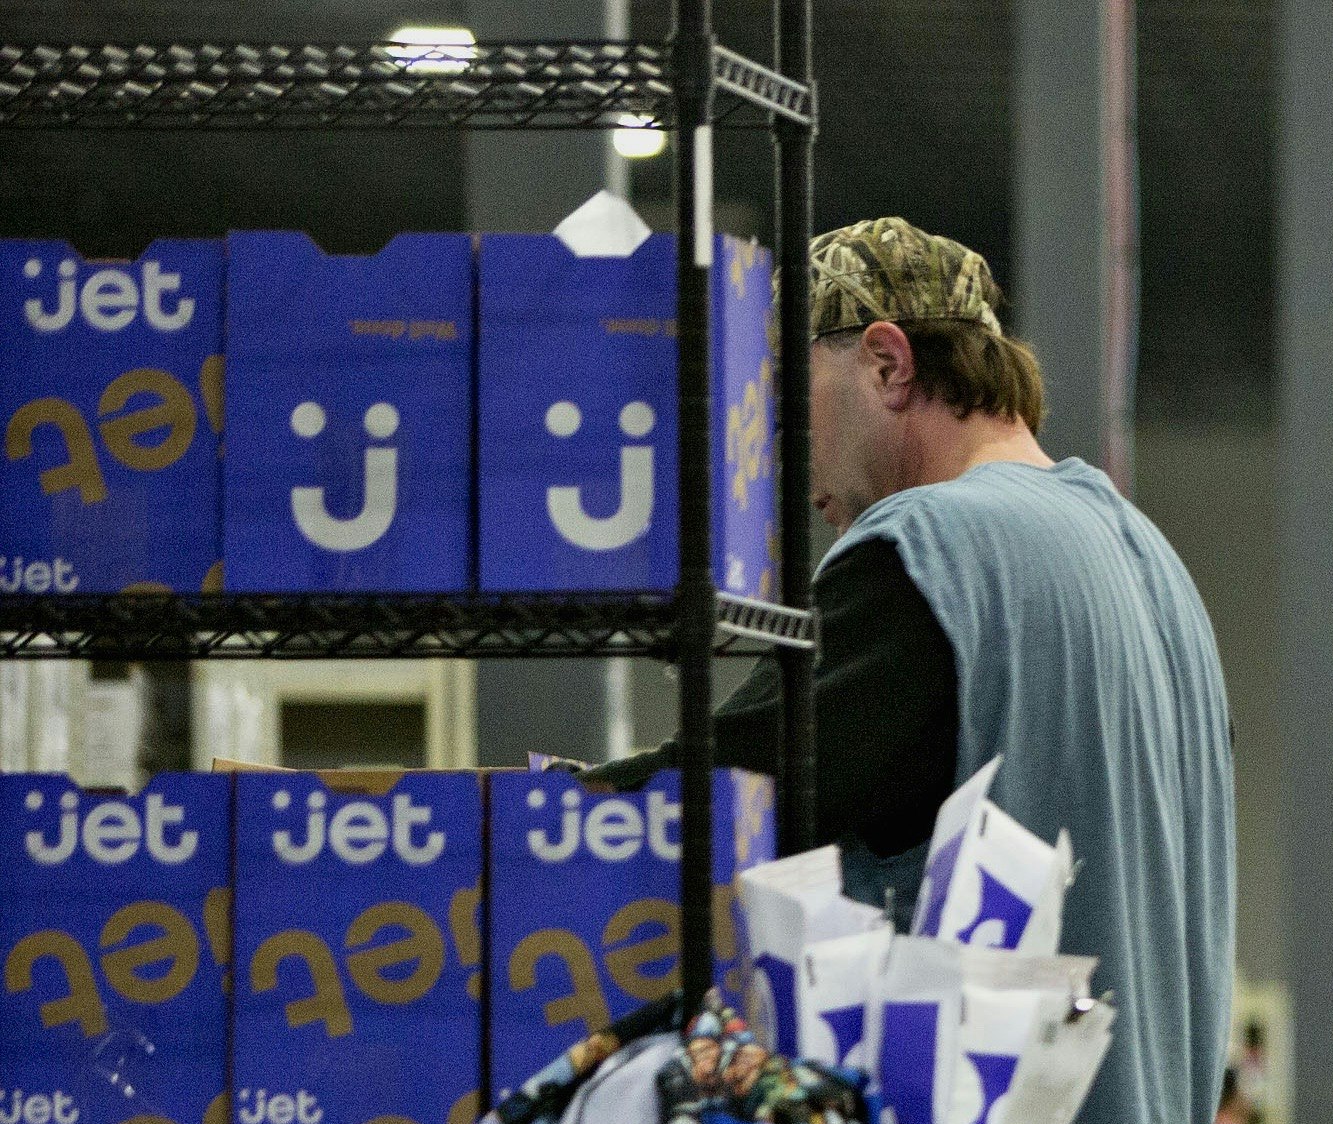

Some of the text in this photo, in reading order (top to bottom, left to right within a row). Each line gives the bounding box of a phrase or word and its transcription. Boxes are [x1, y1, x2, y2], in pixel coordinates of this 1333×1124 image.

[24, 258, 195, 332] jet
[25, 792, 198, 864] jet
[273, 791, 445, 865] jet
